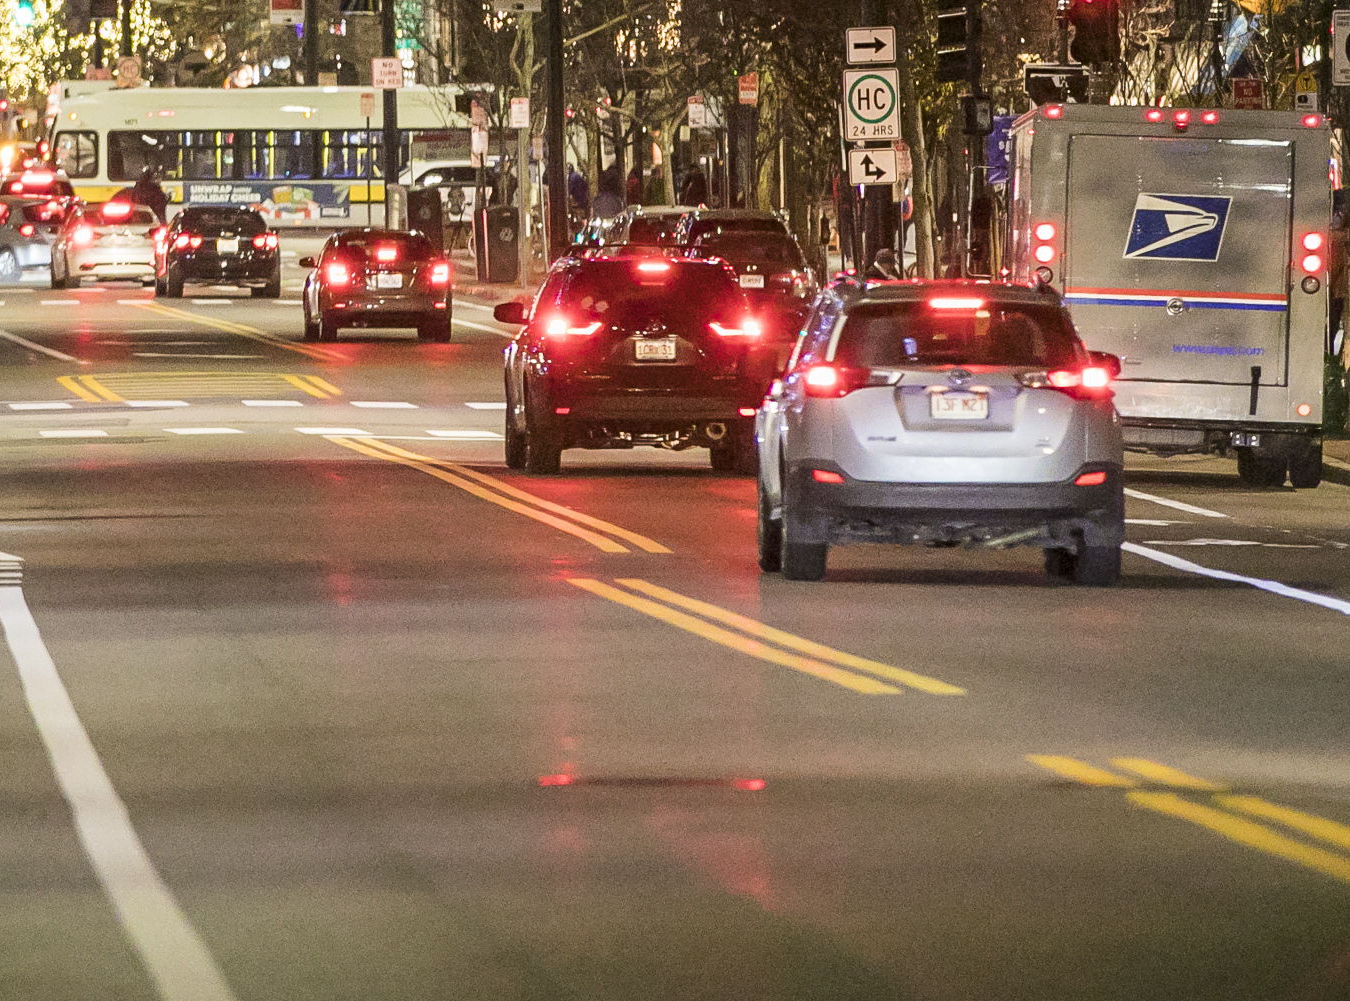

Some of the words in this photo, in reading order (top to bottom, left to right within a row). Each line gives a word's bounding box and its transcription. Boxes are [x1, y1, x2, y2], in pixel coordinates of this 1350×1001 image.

[857, 87, 886, 110] HC
[853, 126, 866, 136] 24
[873, 125, 893, 135] HRS
[190, 185, 232, 193] UNWRAP
